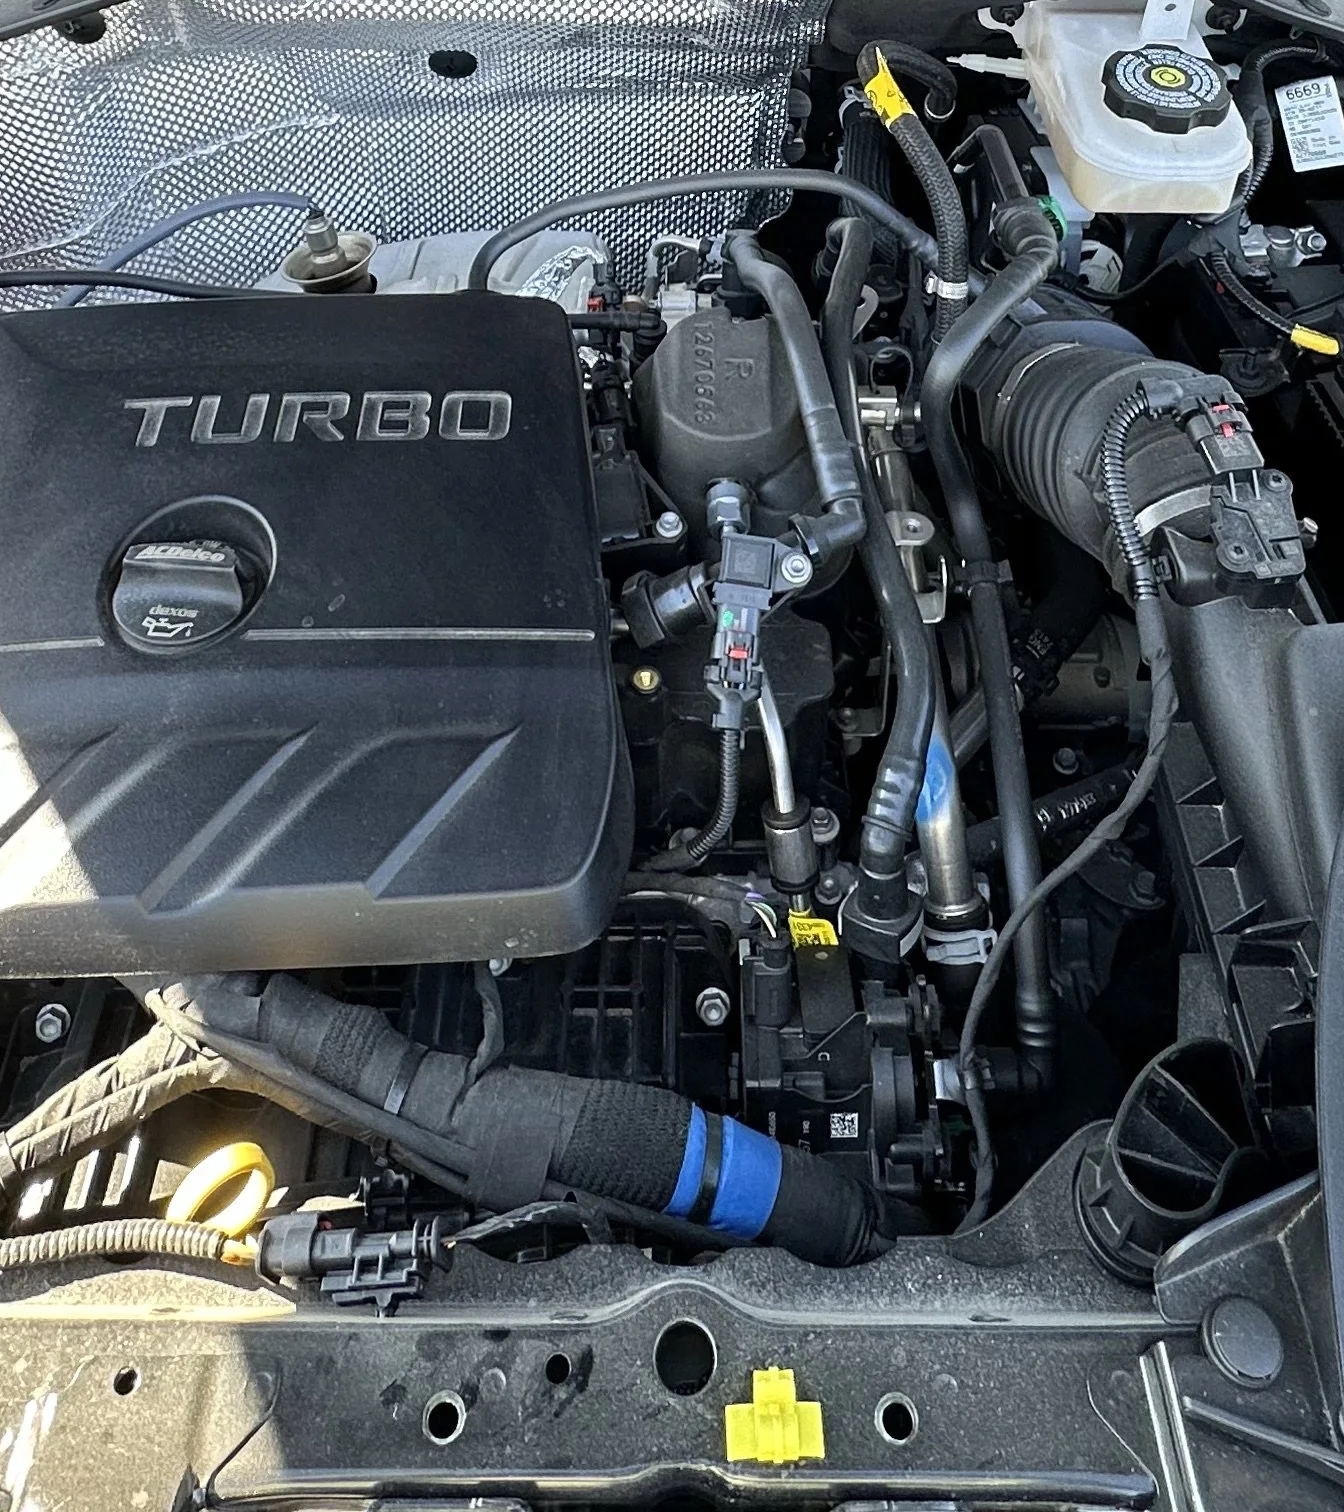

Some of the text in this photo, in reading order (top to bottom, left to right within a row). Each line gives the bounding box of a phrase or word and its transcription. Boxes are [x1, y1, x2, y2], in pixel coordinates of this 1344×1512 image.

[1285, 82, 1321, 101] 6669
[724, 357, 754, 381] R
[123, 389, 513, 448] TURBO
[135, 544, 226, 562] ACDelco
[148, 604, 200, 619] dexos
